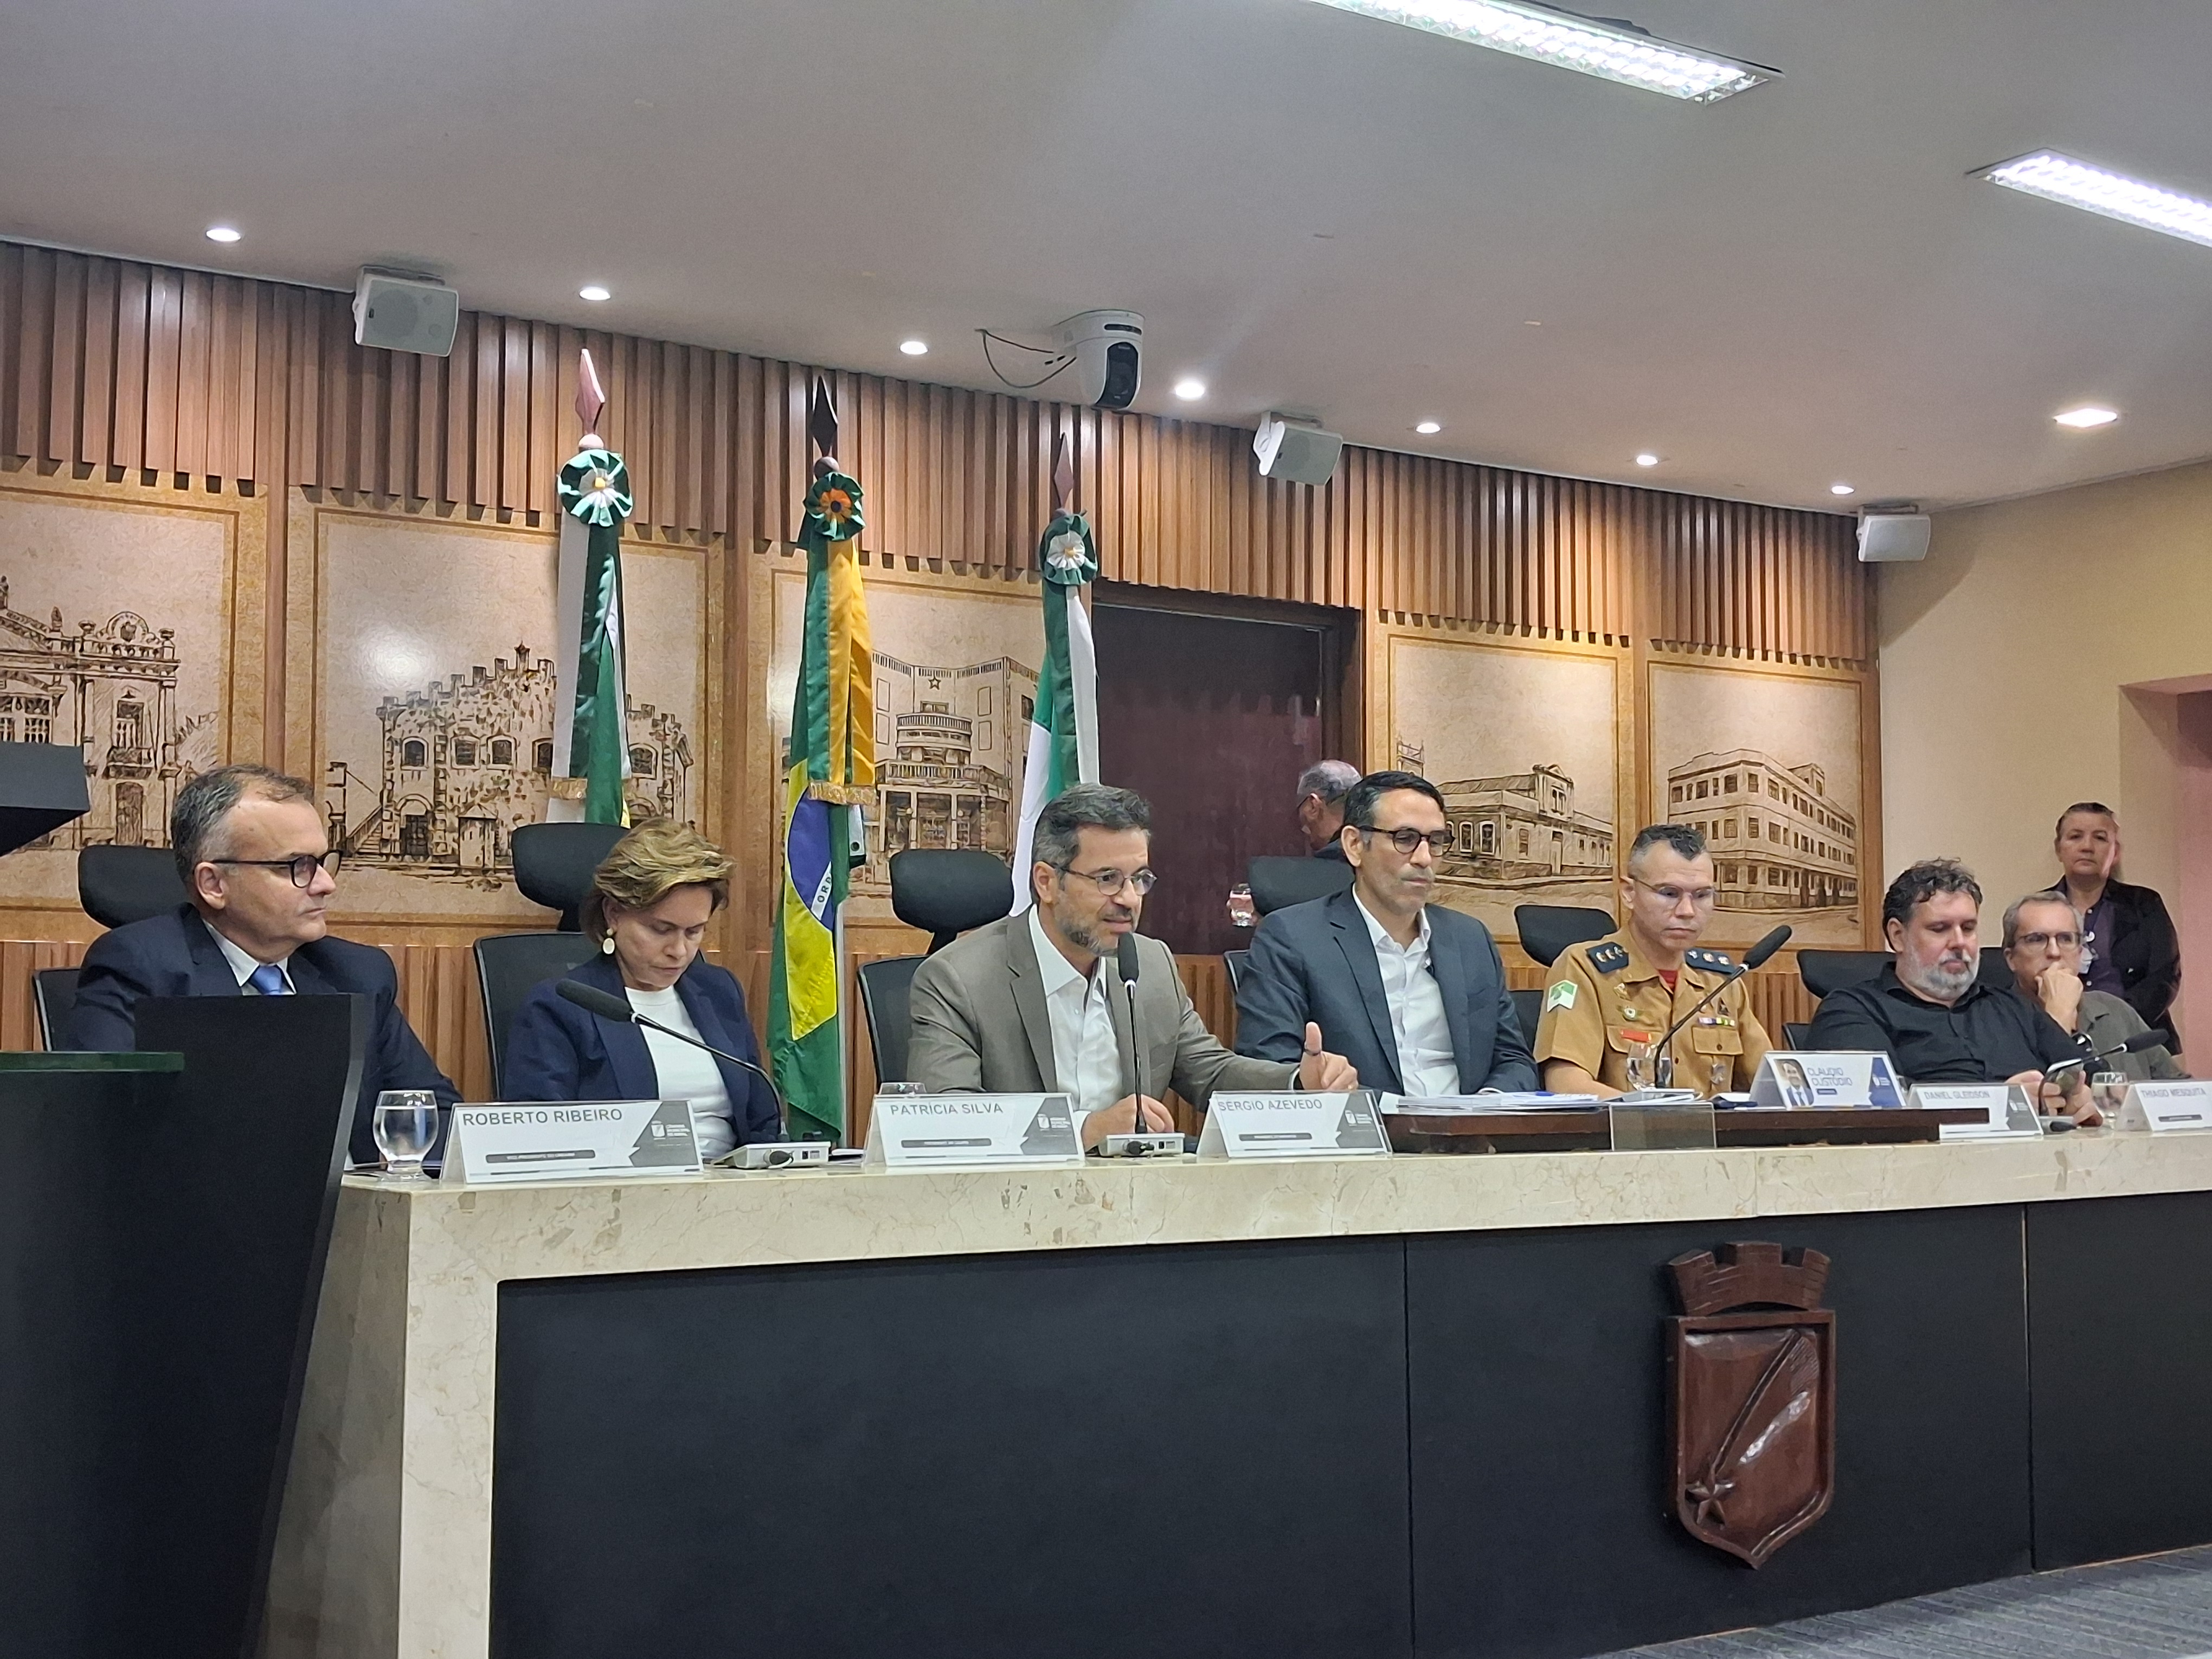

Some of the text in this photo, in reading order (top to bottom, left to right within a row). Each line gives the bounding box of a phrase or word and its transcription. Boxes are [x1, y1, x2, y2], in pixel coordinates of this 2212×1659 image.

[962, 1103, 1004, 1114] SILVA
[1268, 1099, 1322, 1110] AZEVEDO
[462, 1108, 622, 1126] ROBERTO RIBEIRO
